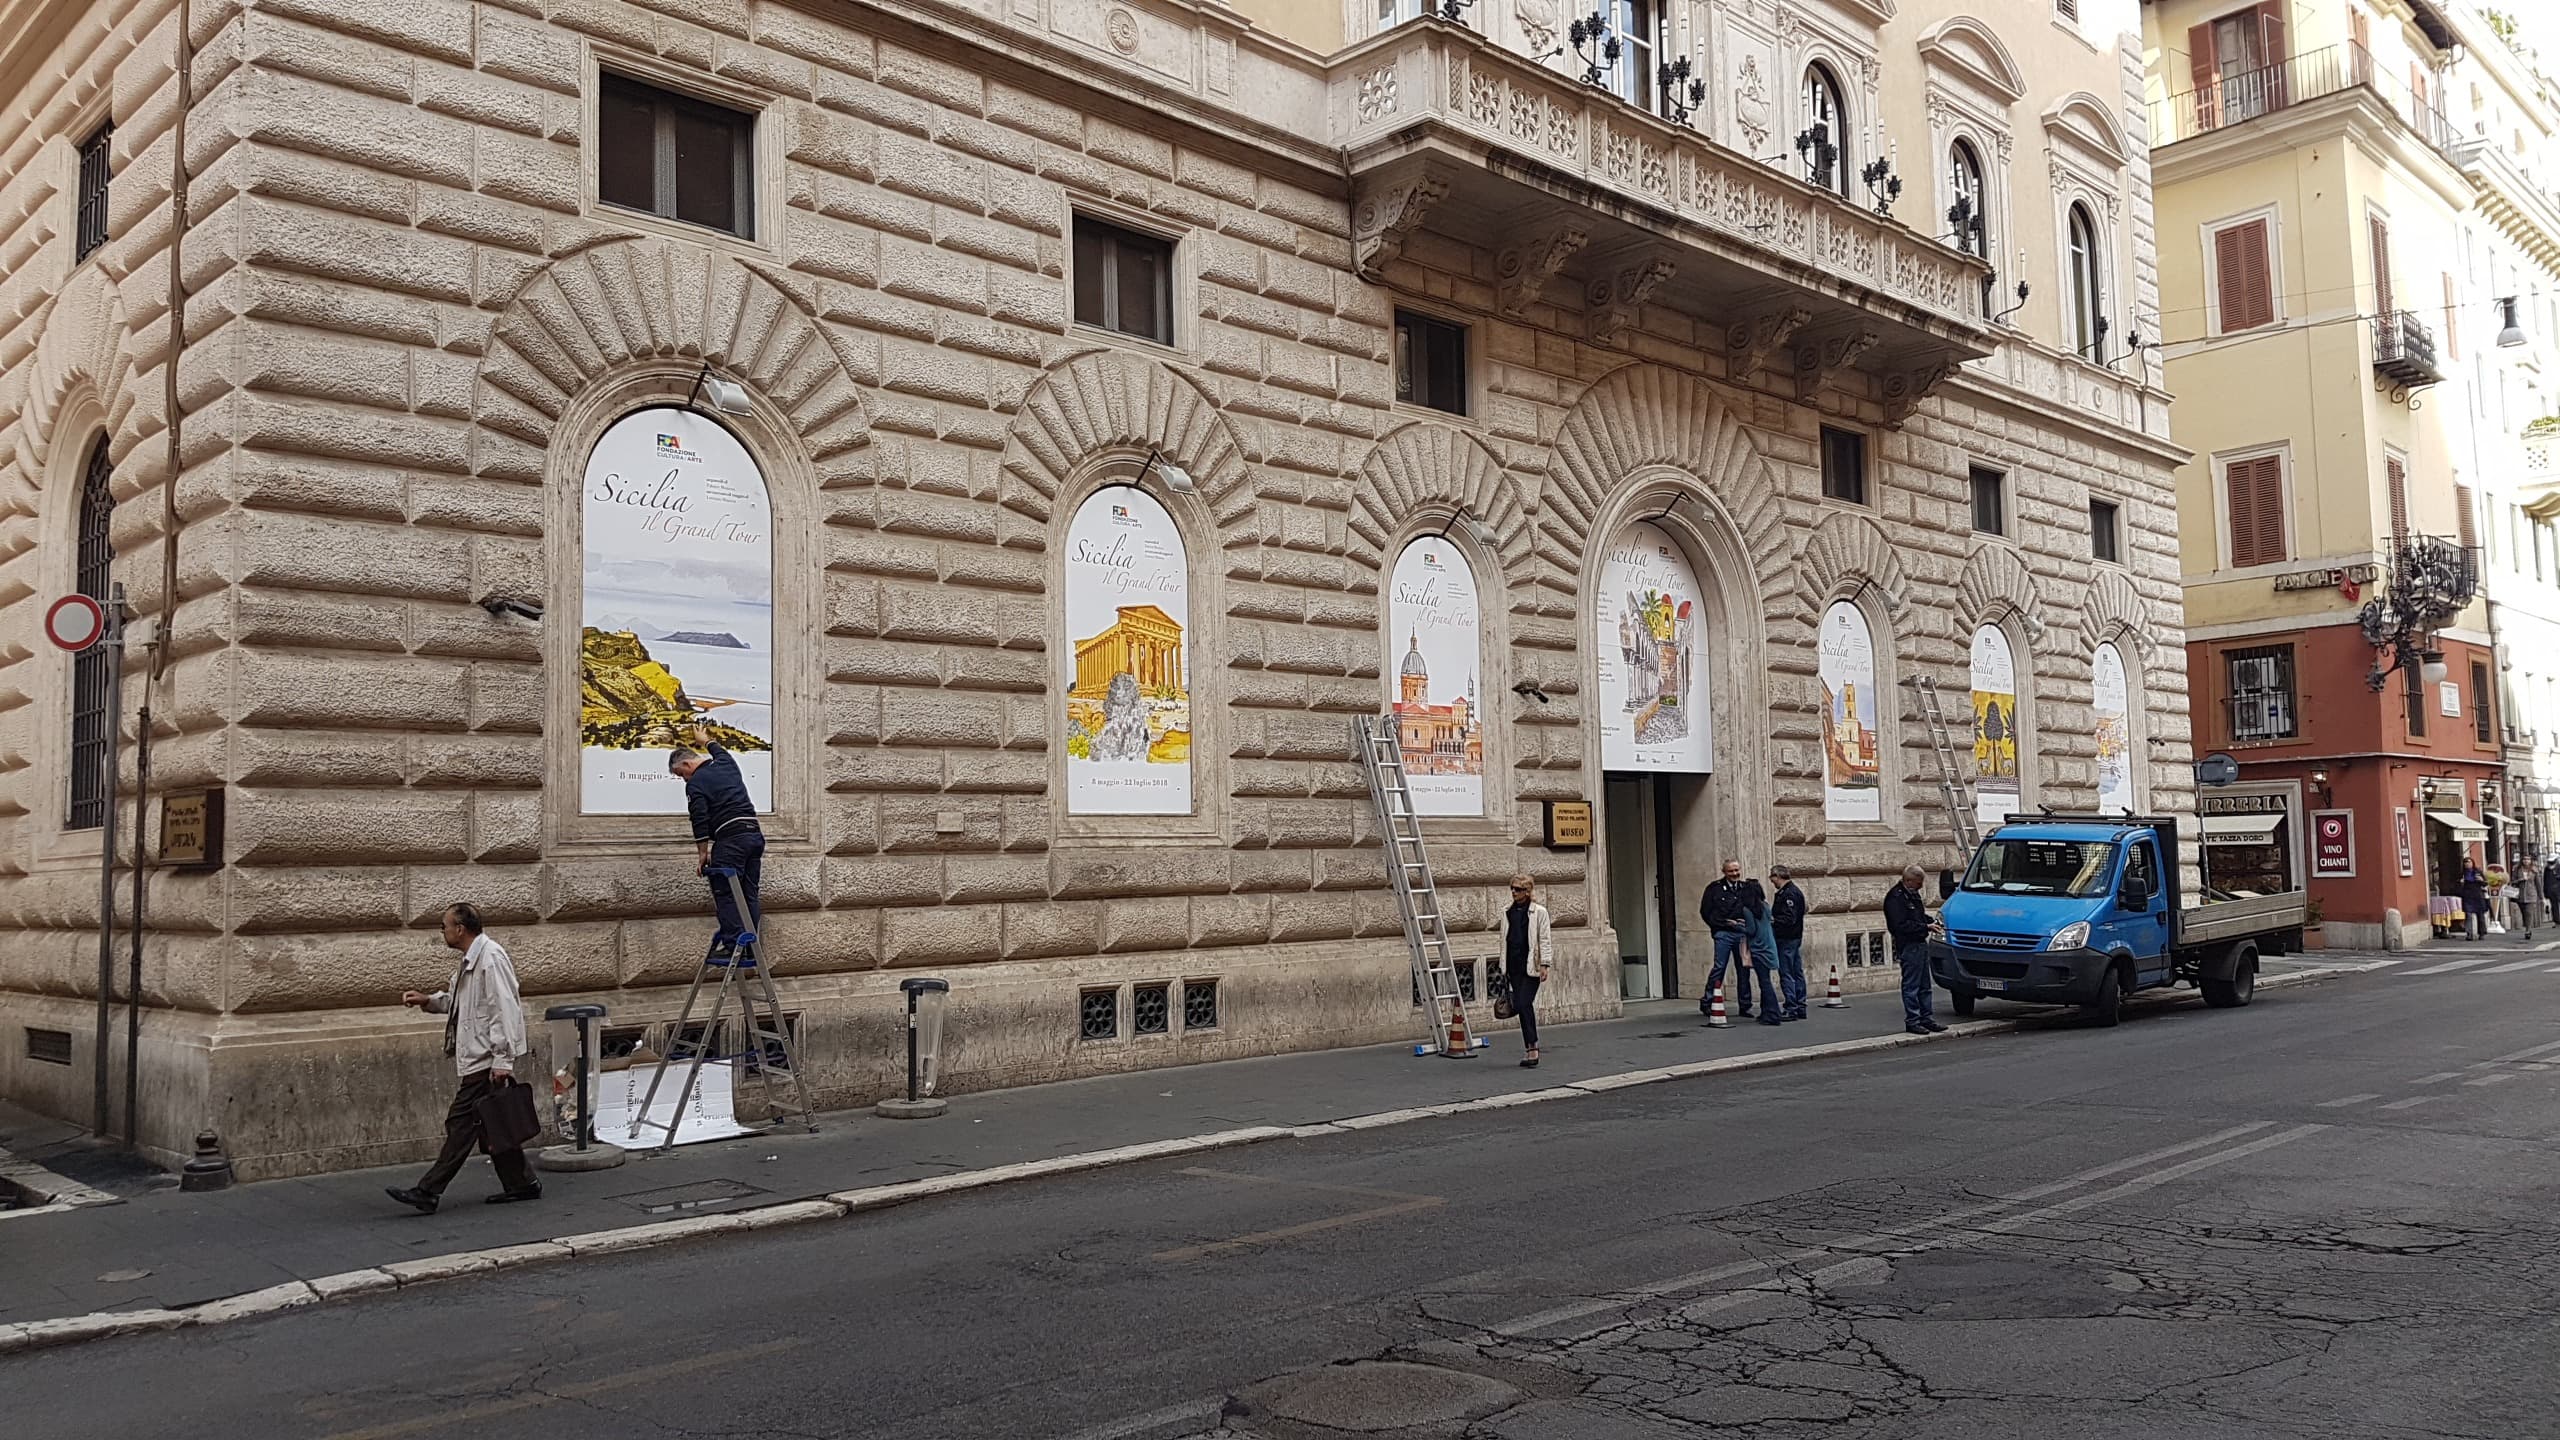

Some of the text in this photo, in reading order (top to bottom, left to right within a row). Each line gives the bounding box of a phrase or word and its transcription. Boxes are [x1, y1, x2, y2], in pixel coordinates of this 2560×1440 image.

[657, 447, 696, 457] FONDAZIONE
[594, 469, 694, 513] Sicilia
[663, 514, 730, 543] Grand
[726, 521, 760, 544] Tour
[1071, 533, 1136, 569] Sicilia
[1607, 531, 1649, 568] icilia
[1116, 569, 1158, 594] Grand
[1157, 574, 1181, 593] Tour
[1635, 567, 1669, 592] Grand
[1667, 573, 1686, 591] Tour
[1395, 577, 1441, 608] Sicilia
[1821, 633, 1849, 658] Sicilia
[628, 772, 663, 782] maggio
[2203, 796, 2287, 813] IRRERIA
[1560, 827, 1584, 837] MUSEO
[2320, 857, 2348, 867] CHIANTI
[2323, 845, 2343, 854] VINO
[1977, 935, 2009, 946] IVECO
